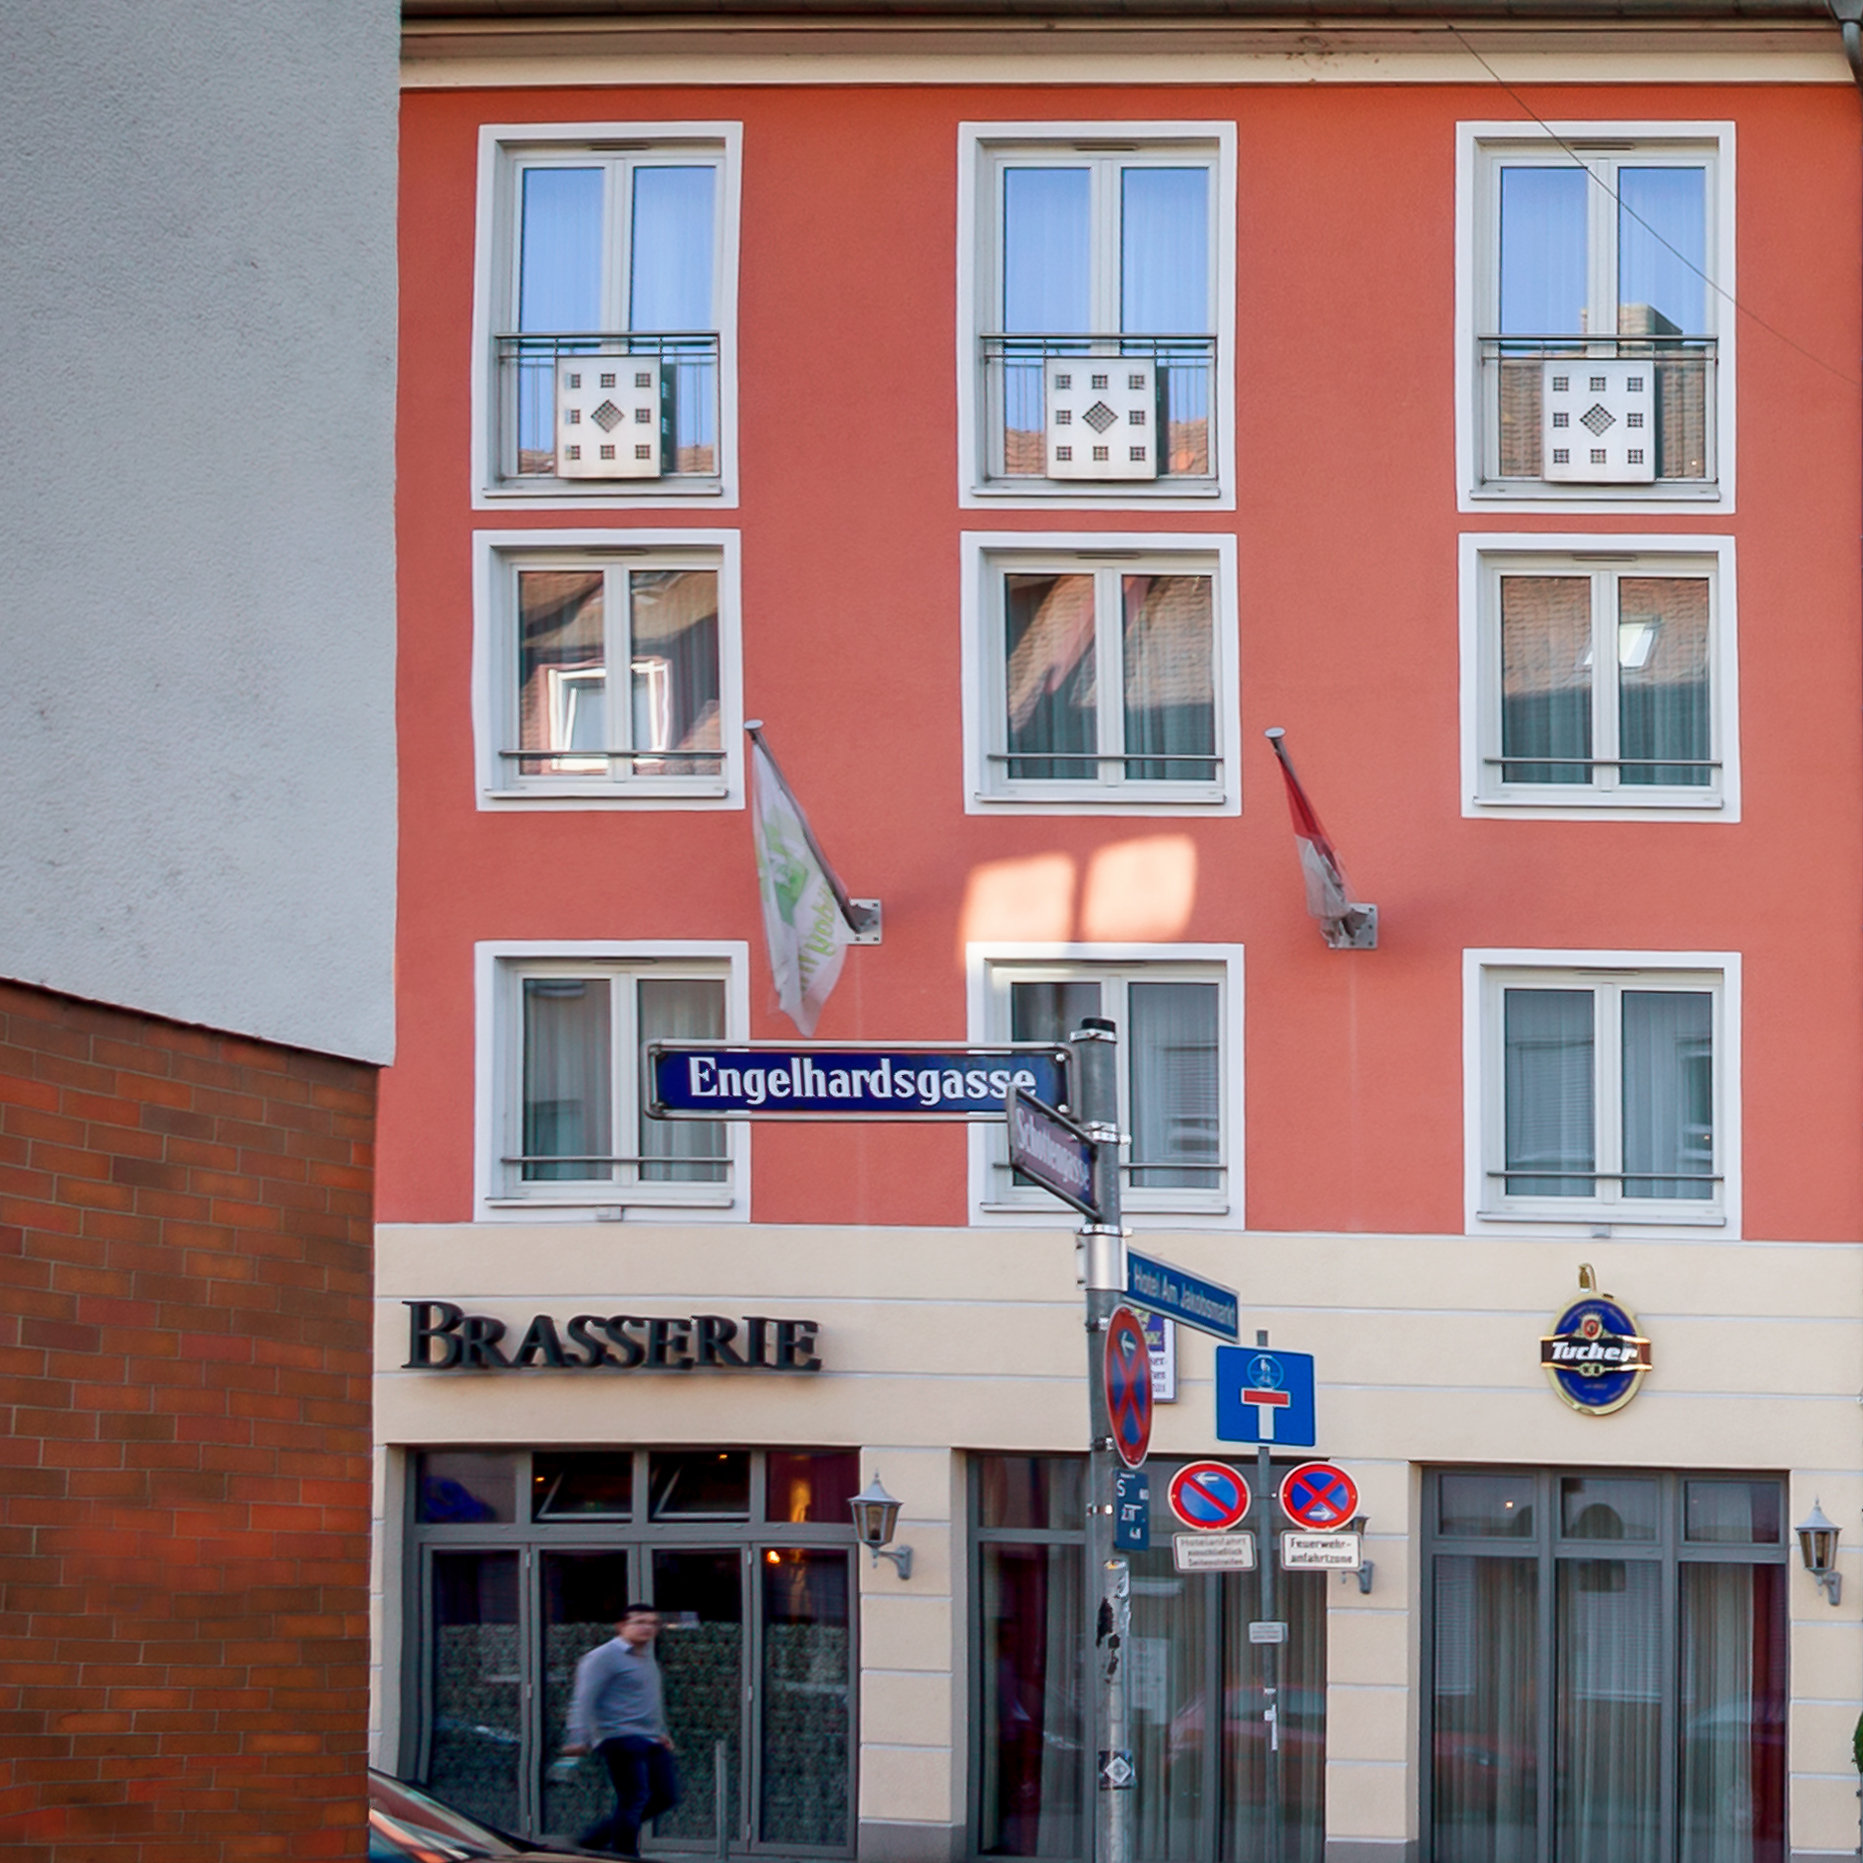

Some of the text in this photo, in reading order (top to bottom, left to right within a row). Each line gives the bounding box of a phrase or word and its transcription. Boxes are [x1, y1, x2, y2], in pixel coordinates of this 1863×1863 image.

[688, 1055, 1037, 1106] Engelhardsgasse
[1133, 1262, 1160, 1298] Hotel
[1551, 1341, 1638, 1362] Tucher
